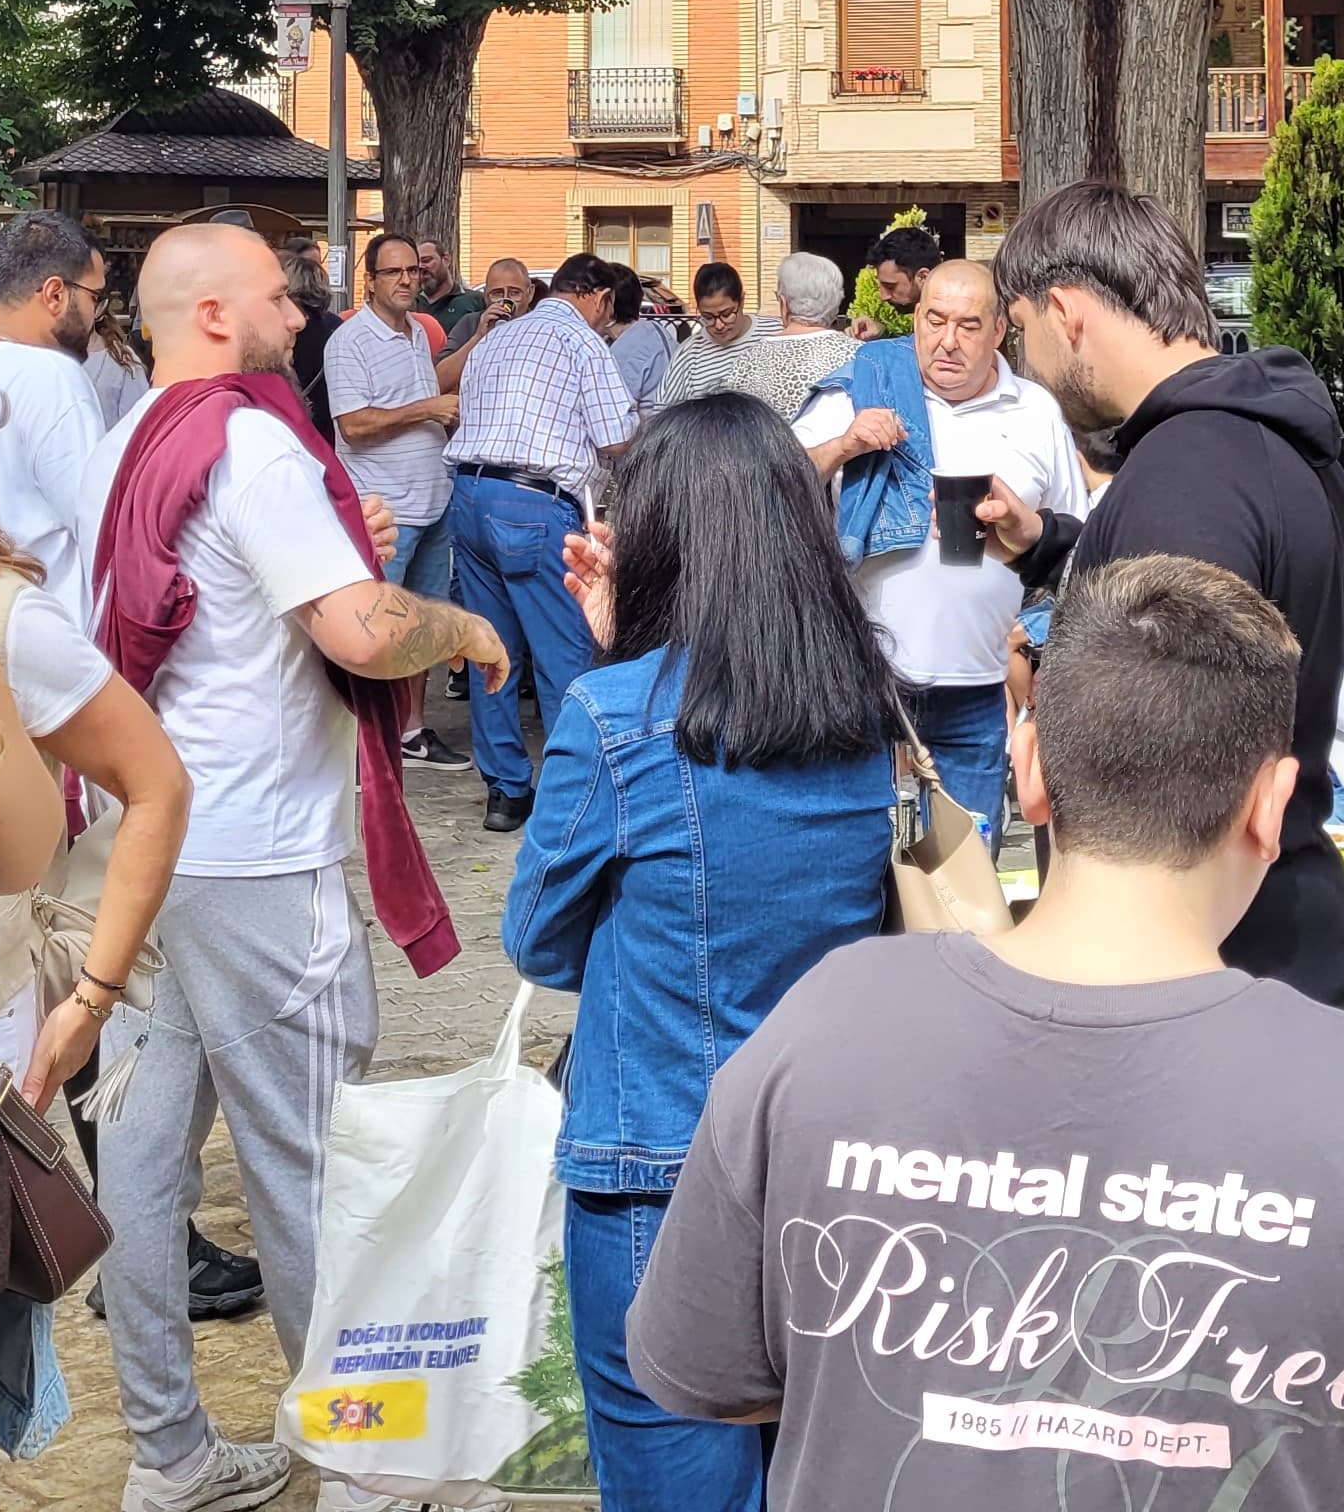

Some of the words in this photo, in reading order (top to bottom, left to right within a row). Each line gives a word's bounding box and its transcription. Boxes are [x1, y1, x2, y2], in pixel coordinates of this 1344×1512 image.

[826, 1138, 1089, 1219] mental
[1099, 1162, 1315, 1247] state:
[780, 1215, 1077, 1372] Risk
[948, 1410, 1002, 1437] 1985
[1036, 1414, 1134, 1448] HAZARD
[1143, 1430, 1212, 1454] DEPT.
